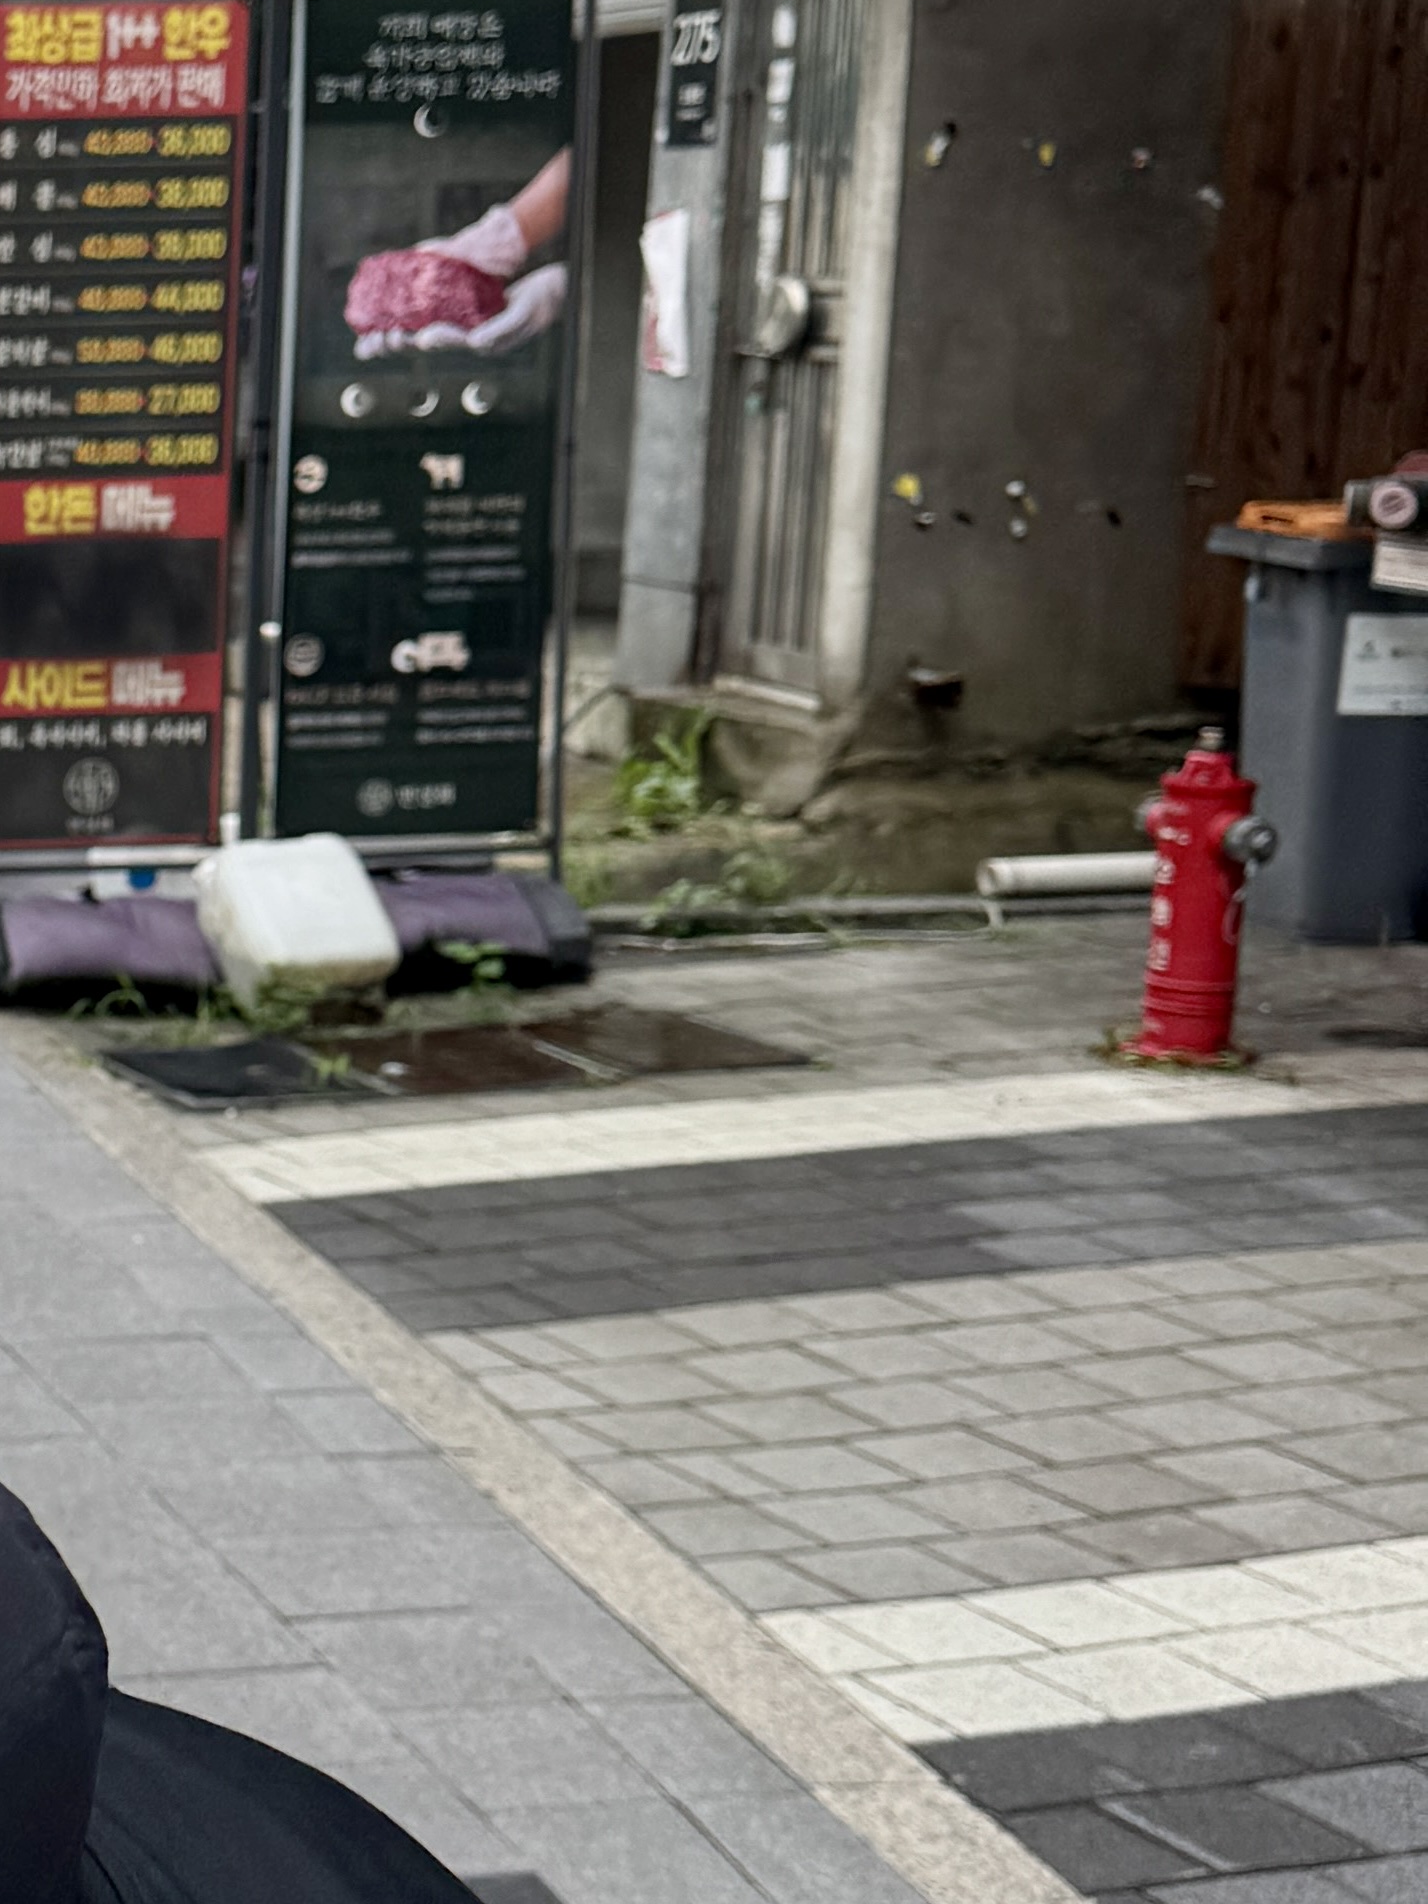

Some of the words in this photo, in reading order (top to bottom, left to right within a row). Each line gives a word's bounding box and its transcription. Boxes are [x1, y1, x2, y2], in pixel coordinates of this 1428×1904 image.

[4, 7, 103, 64] 최상급
[162, 3, 232, 62] 한우
[176, 62, 228, 109] 판매
[23, 483, 96, 536] 한돈
[100, 483, 175, 533] 메뉴
[1, 660, 108, 710] 사이드
[111, 660, 186, 707] 메뉴
